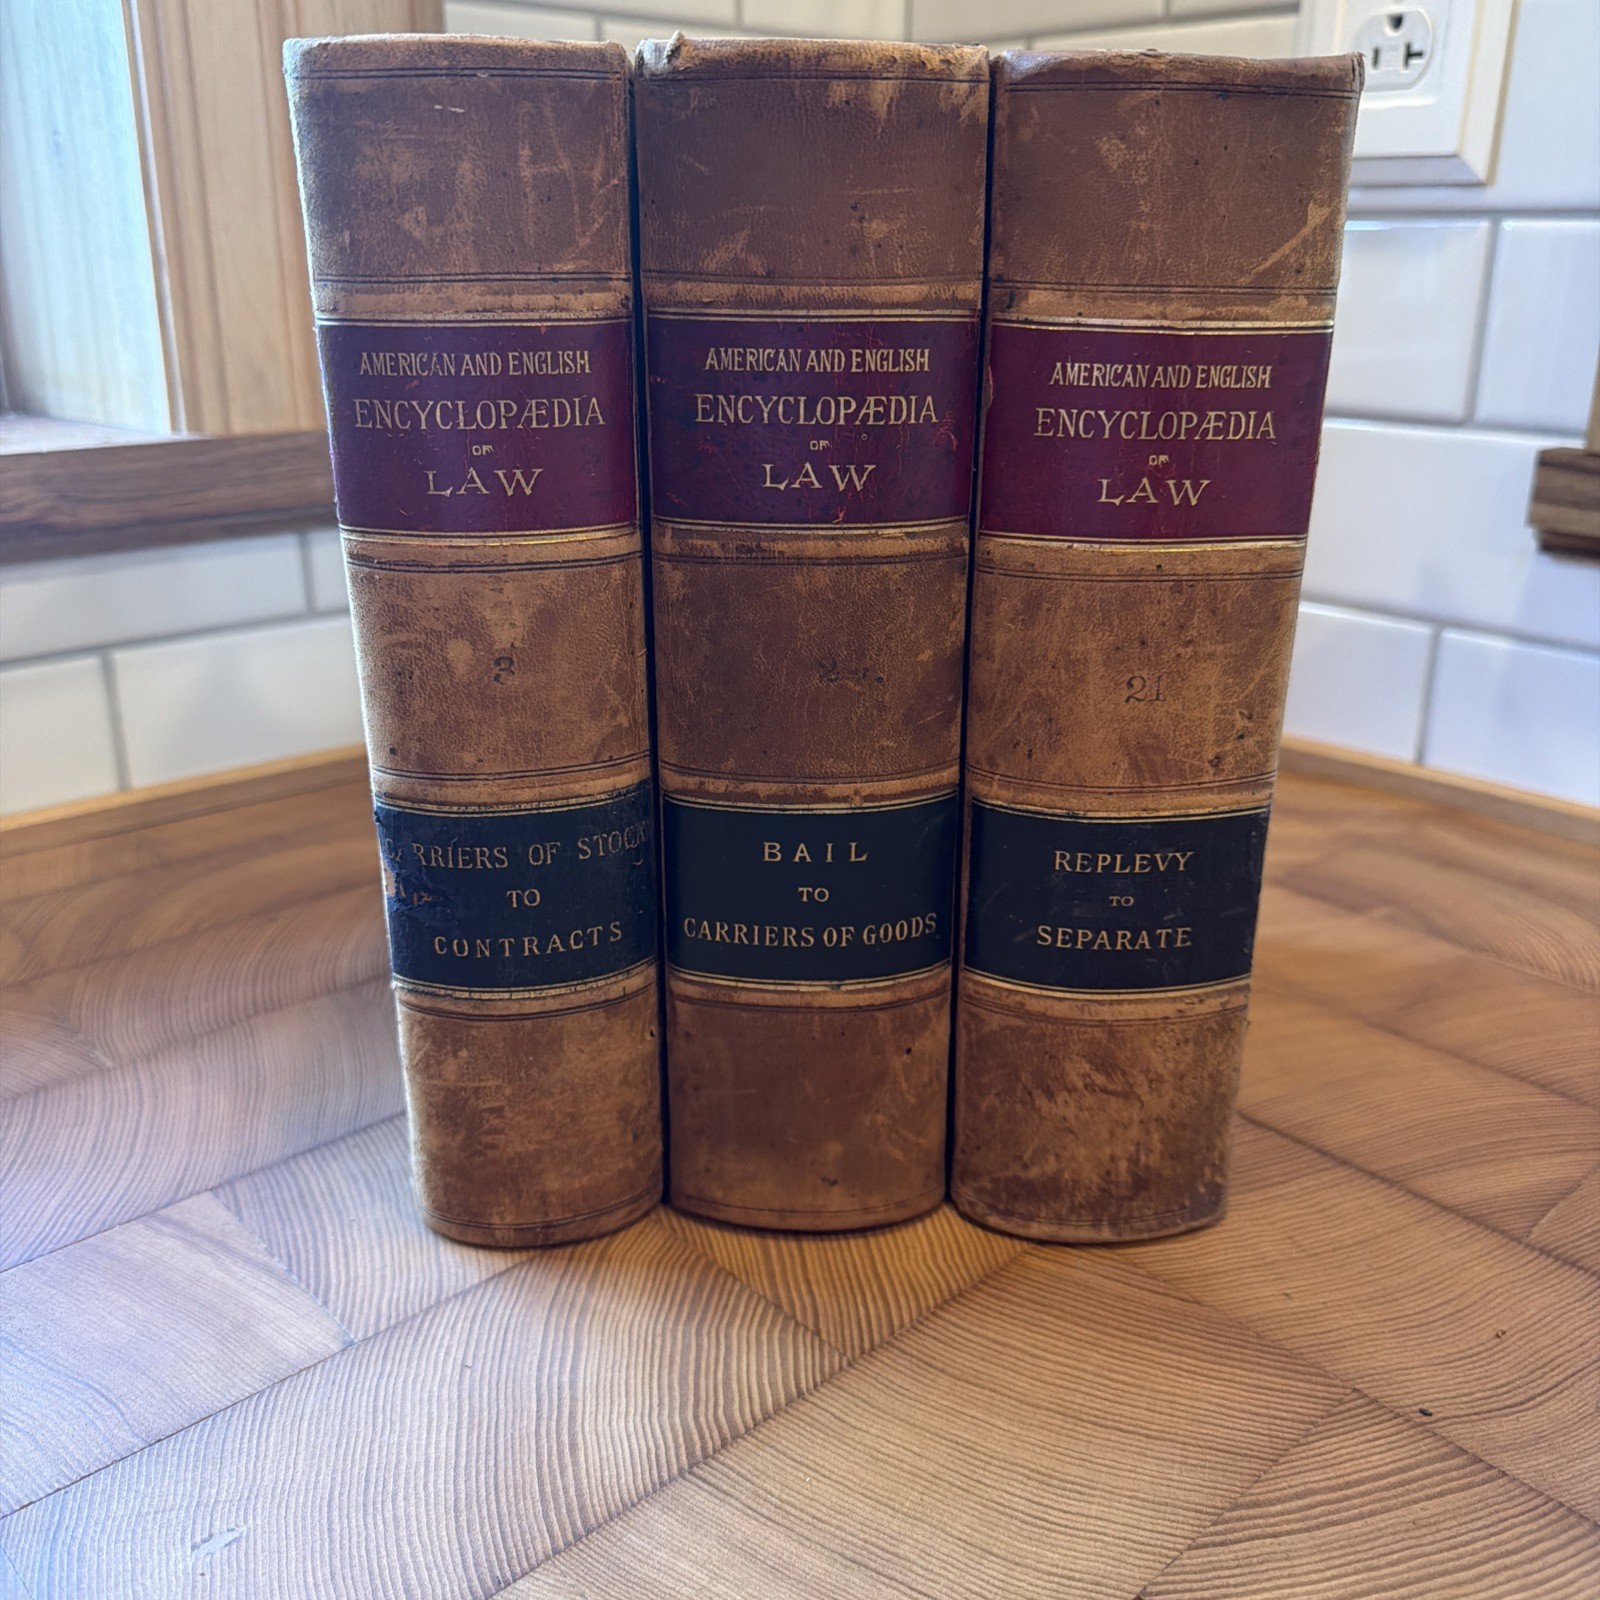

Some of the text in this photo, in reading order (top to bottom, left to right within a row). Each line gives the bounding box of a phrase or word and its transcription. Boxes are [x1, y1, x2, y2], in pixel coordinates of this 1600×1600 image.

[359, 350, 592, 376] AMERICAN AND ENGLISH
[703, 348, 930, 373] AMERICAN AND ENGLISH
[1049, 362, 1273, 389] AMERICAN AND ENGLISH
[352, 396, 606, 430] ENCYCLOPÆDIA
[694, 393, 939, 425] ENCYCLOPÆDIA
[1034, 407, 1277, 440] ENCYCLOPÆDIA
[472, 444, 494, 456] OF
[809, 440, 831, 451] OF
[1149, 455, 1170, 466] OF
[423, 466, 544, 497] LAW
[762, 461, 877, 492] LAW
[1097, 477, 1211, 506] LAW
[1124, 675, 1167, 703] 21
[528, 841, 561, 867] OF
[762, 841, 869, 863] BAIL
[1053, 850, 1194, 874] REPLEVY
[507, 889, 541, 908] TO
[798, 887, 830, 903] TO
[1109, 895, 1135, 907] TO
[434, 920, 623, 959] CONTRACTS
[683, 912, 938, 948] CARRIERS OF GOODS
[1036, 925, 1193, 950] SEPARATE
